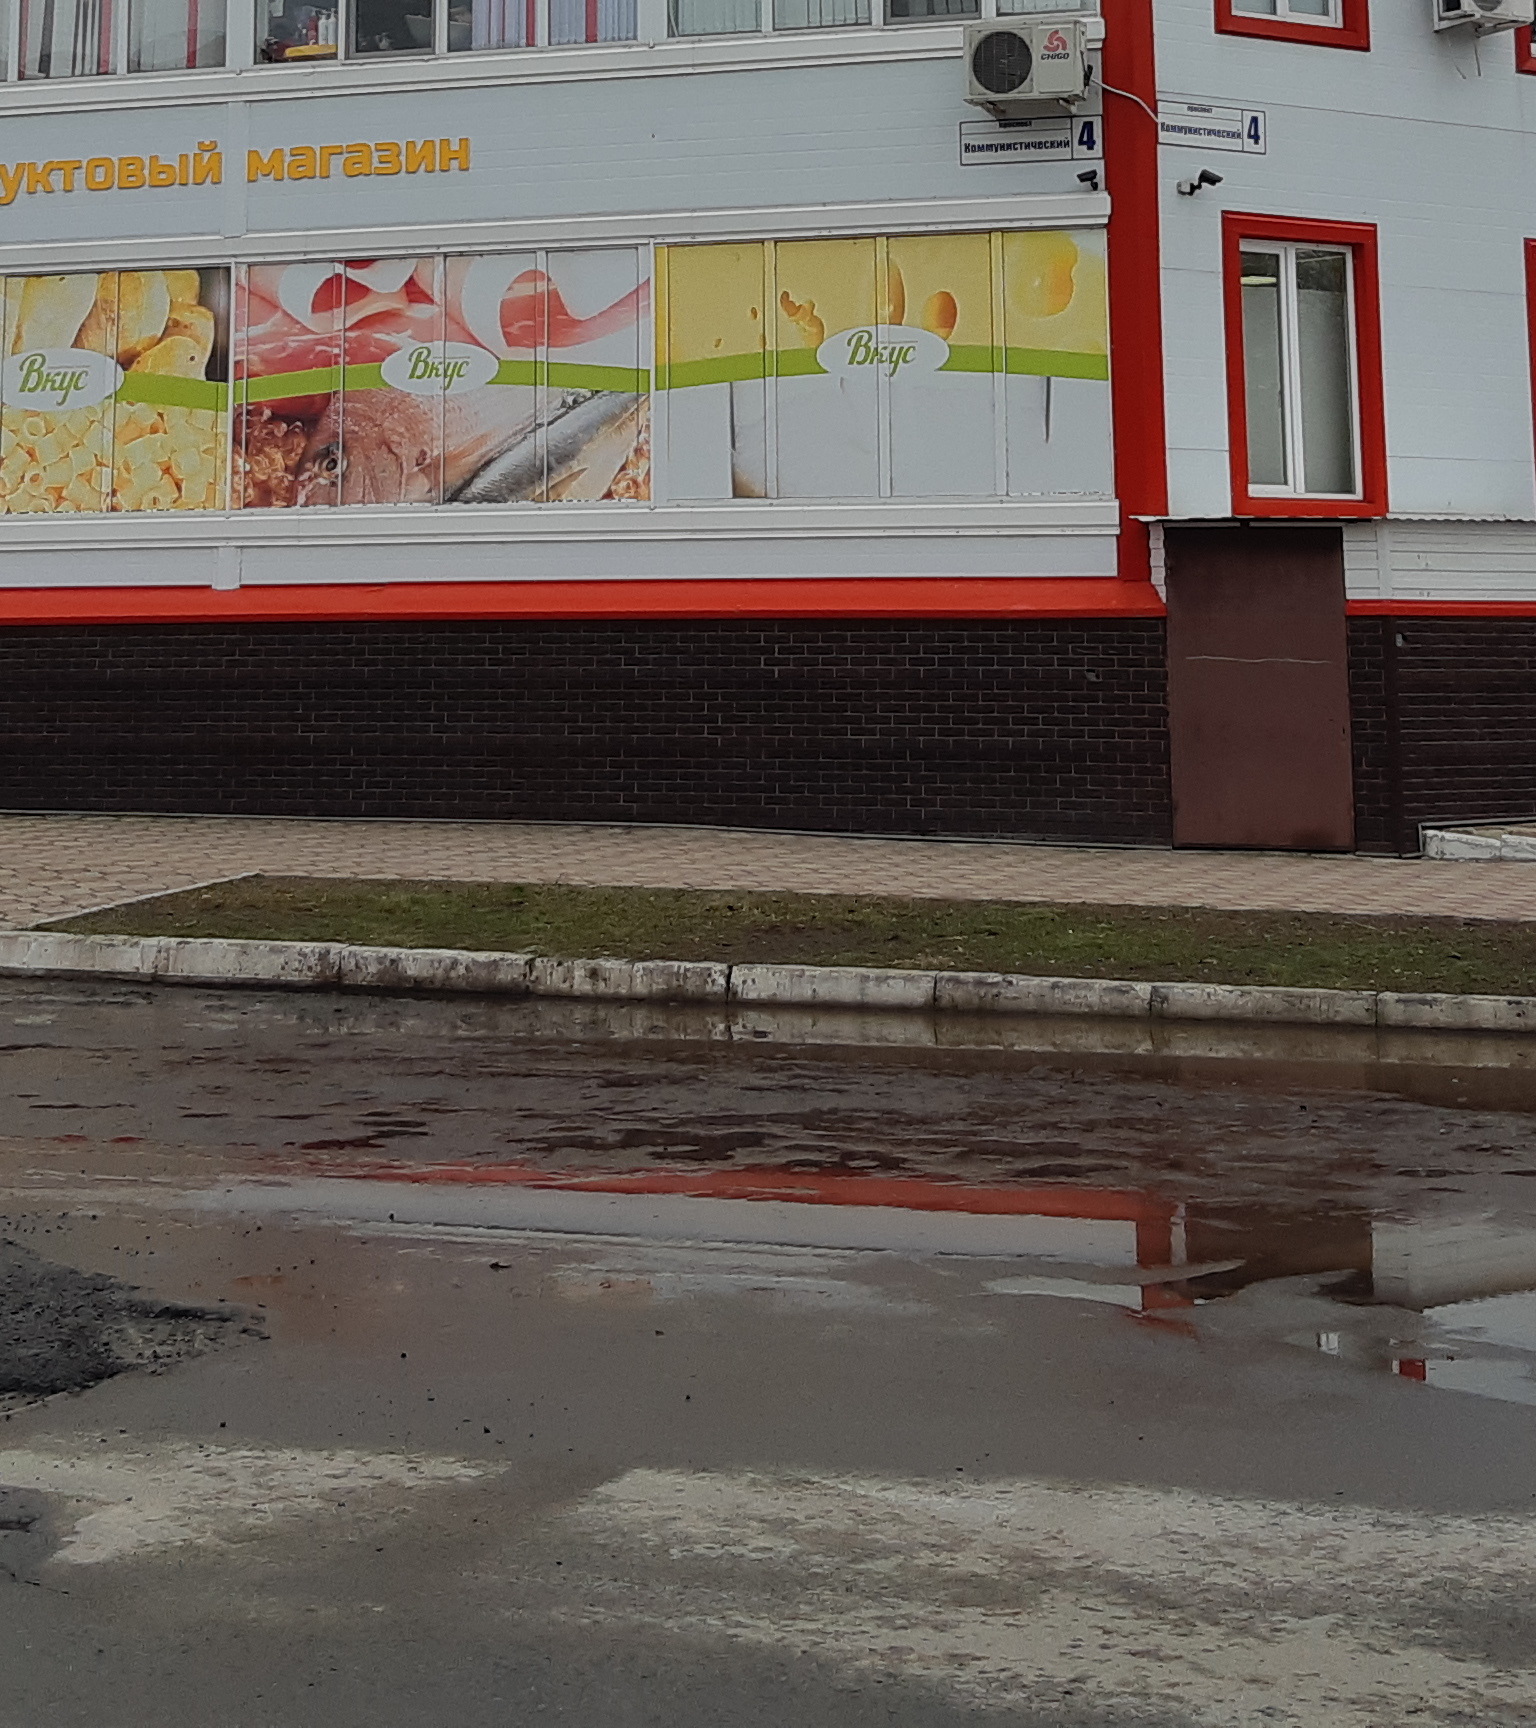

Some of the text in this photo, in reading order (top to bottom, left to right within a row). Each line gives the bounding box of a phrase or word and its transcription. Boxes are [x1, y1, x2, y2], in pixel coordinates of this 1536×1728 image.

[964, 120, 1097, 154] Коммунистический 4
[1160, 115, 1261, 146] Коммунистический 4
[247, 137, 470, 183] магазин
[408, 345, 470, 389] Вкус
[847, 331, 918, 377] Вкус
[19, 351, 89, 404] Вкус
